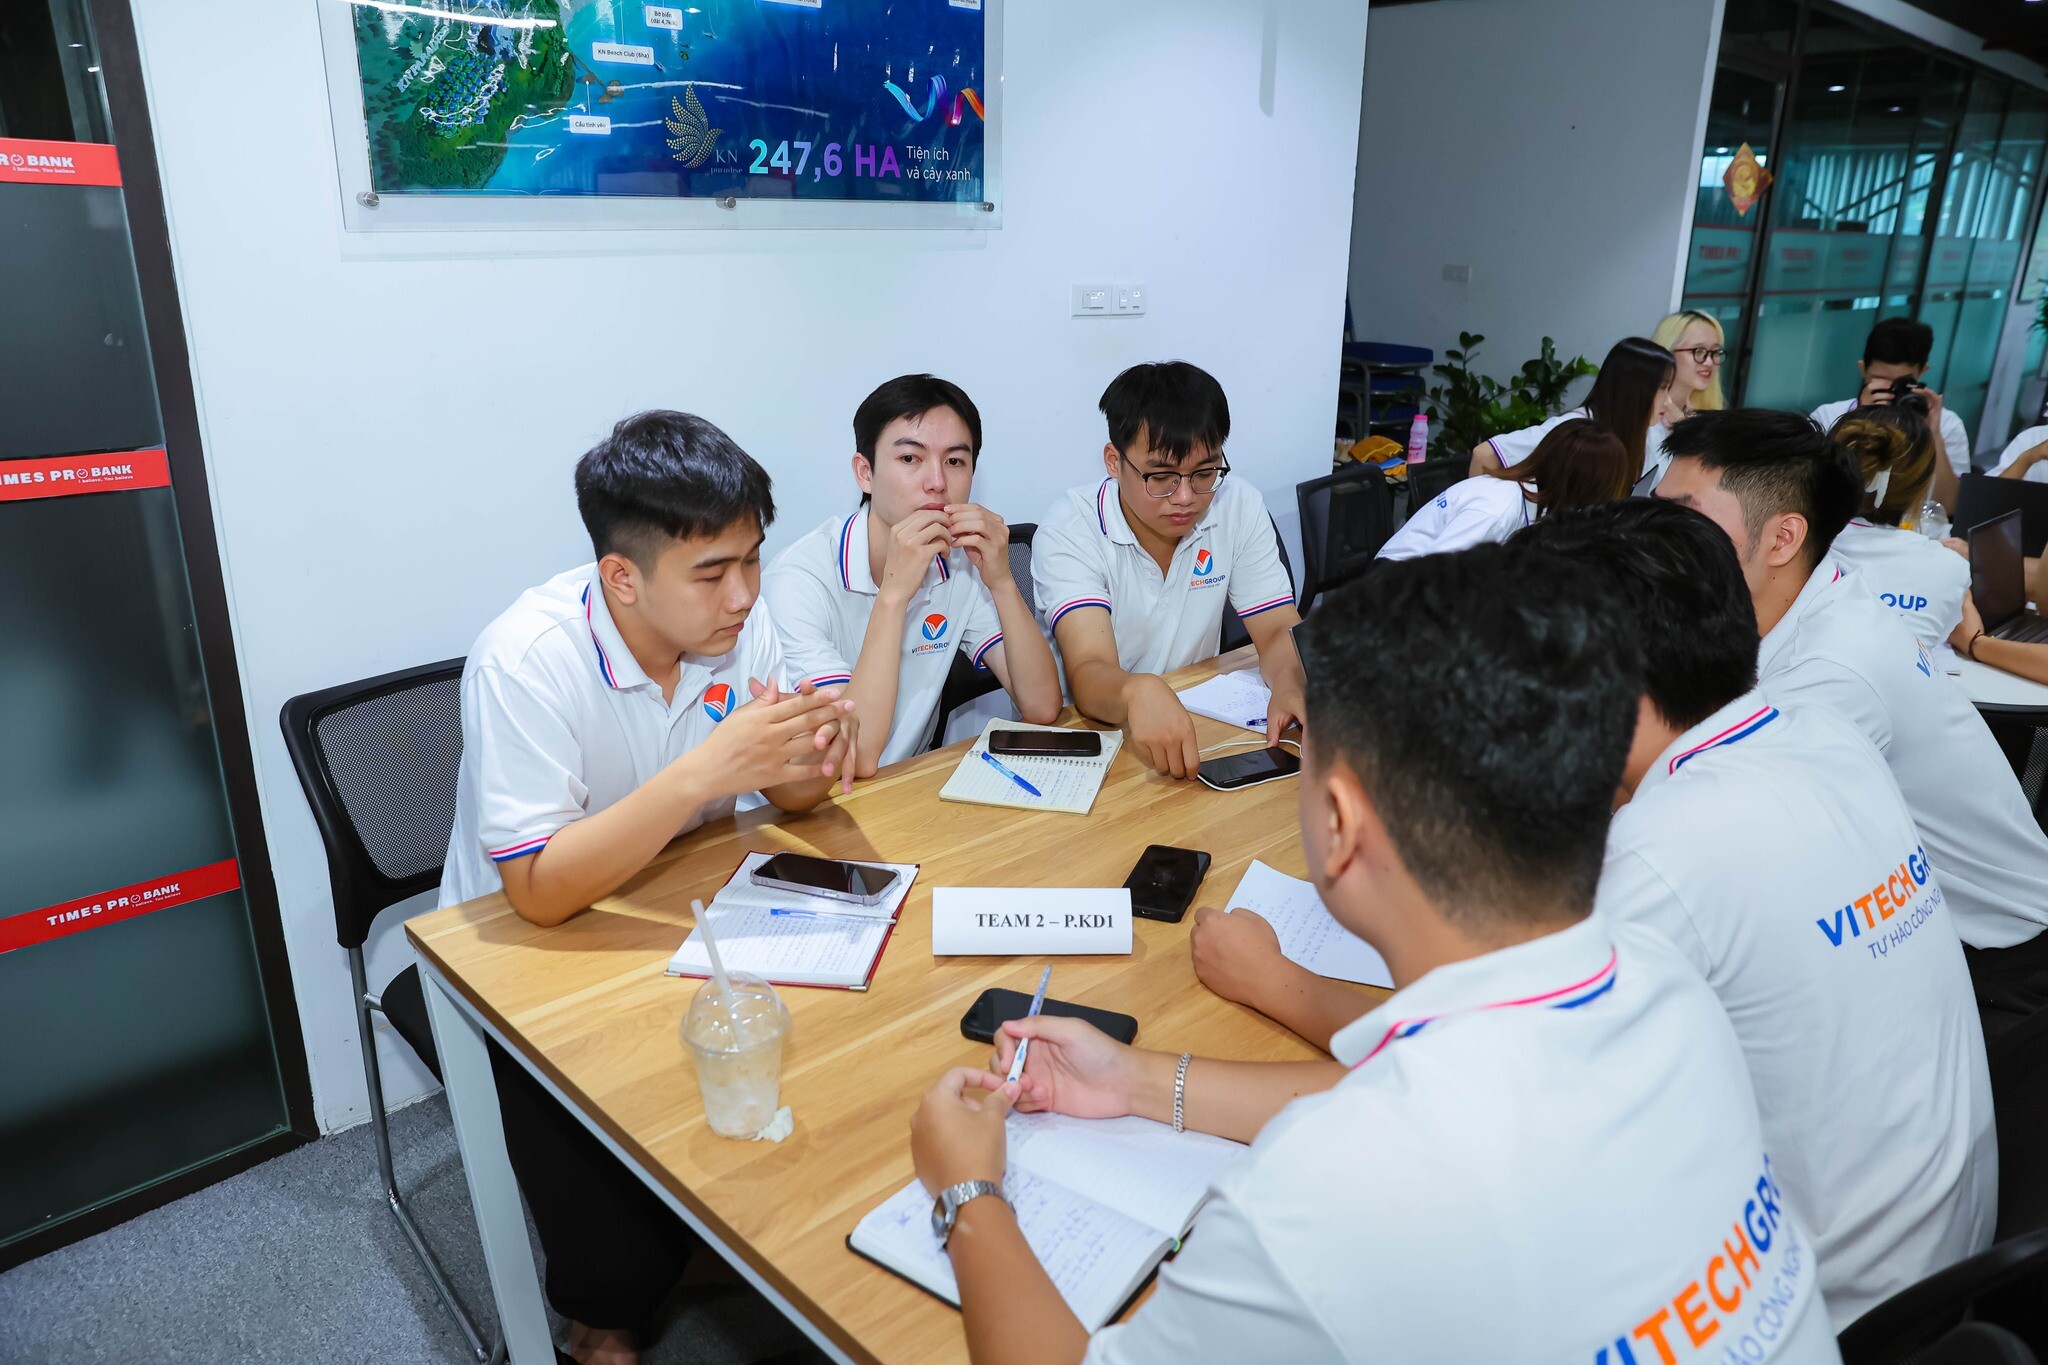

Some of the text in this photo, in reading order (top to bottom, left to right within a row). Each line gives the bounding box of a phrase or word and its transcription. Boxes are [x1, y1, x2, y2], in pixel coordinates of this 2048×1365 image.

[26, 155, 75, 168] BANK
[715, 149, 738, 163] KN
[748, 138, 901, 183] 247,6 HA
[906, 145, 949, 162] Tiện ích
[906, 166, 971, 182] và cây xanh
[91, 464, 132, 477] BANK
[47, 904, 103, 926] TIMES
[143, 883, 180, 900] BANK
[975, 913, 1031, 928] TEAM
[1036, 913, 1045, 928] 2
[1064, 913, 1114, 928] P.KD1
[1867, 935, 1889, 959] TỰ
[1889, 921, 1913, 948] HÀO
[1911, 900, 1934, 929] CÔNG
